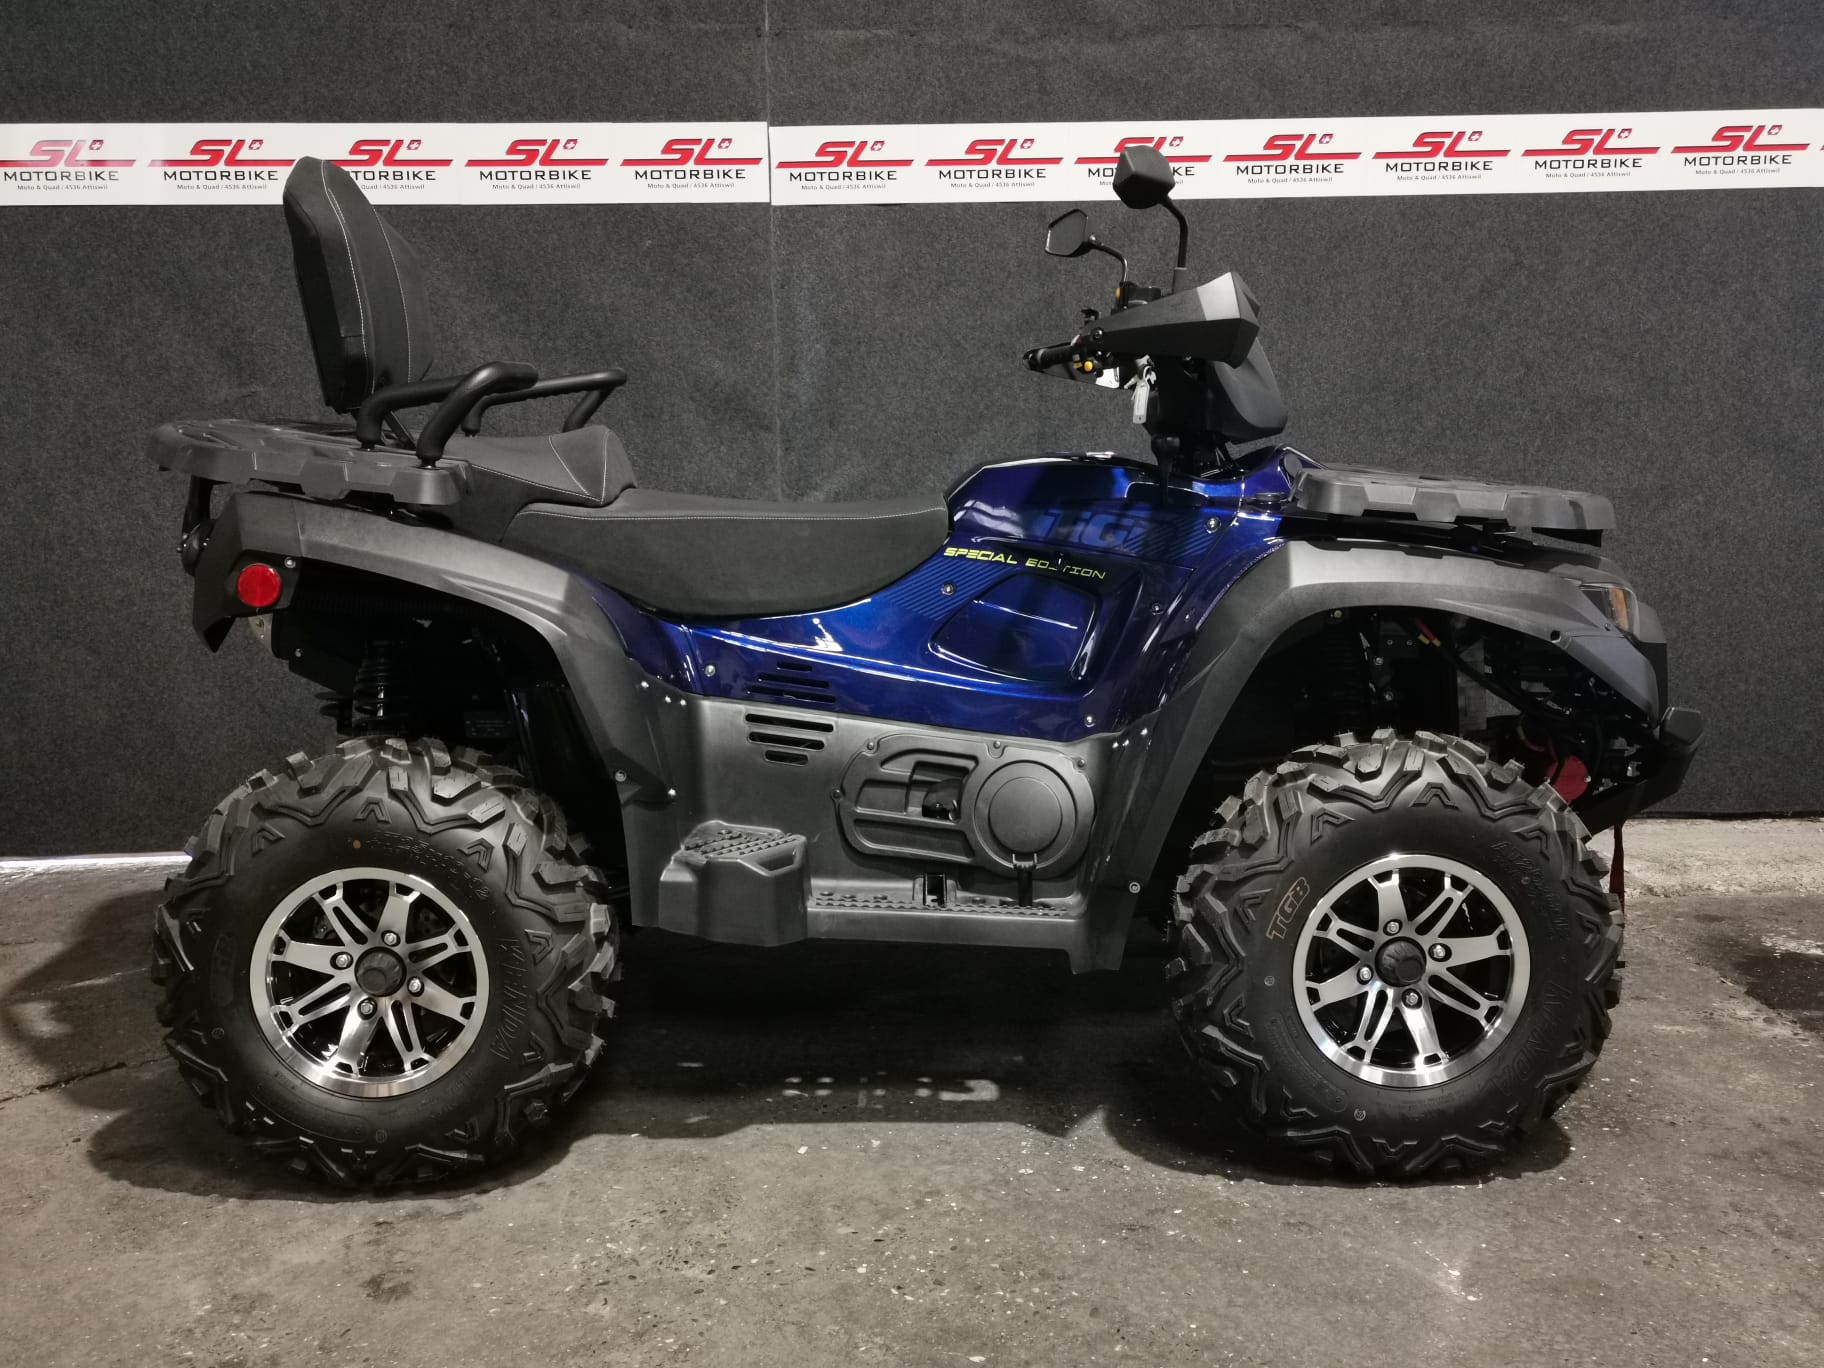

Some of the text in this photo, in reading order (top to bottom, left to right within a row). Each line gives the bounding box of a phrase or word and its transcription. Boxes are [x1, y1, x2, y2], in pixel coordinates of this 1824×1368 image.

[1534, 158, 1643, 170] MOTORBIKE
[1684, 155, 1793, 167] MOTORBIKE
[1236, 163, 1344, 176] MOTORBIKE
[1385, 161, 1493, 173] MOTORBIKE
[1719, 168, 1737, 176] Quad
[4, 171, 119, 182] MOTORBIKE
[163, 170, 279, 181] MOTORBIKE
[351, 170, 436, 181] TORBIKE
[479, 169, 592, 181] MOTORBIKE
[634, 169, 746, 180] MOTORBIKE
[789, 170, 897, 182] MOTORBIKE
[939, 169, 1046, 180] MOTORBIKE
[1420, 174, 1438, 182] Quad
[950, 181, 968, 189] Moto
[974, 181, 991, 190] Quad
[1271, 177, 1289, 185] Quad
[43, 184, 61, 192] Quad
[176, 183, 195, 191] Moto
[202, 183, 220, 192] Quad
[361, 183, 379, 192] Quad
[517, 183, 535, 191] Quad
[672, 183, 689, 191] Quad
[825, 184, 843, 192] Quad
[943, 547, 1018, 565] SPECIAL
[1265, 876, 1311, 940] TGB
